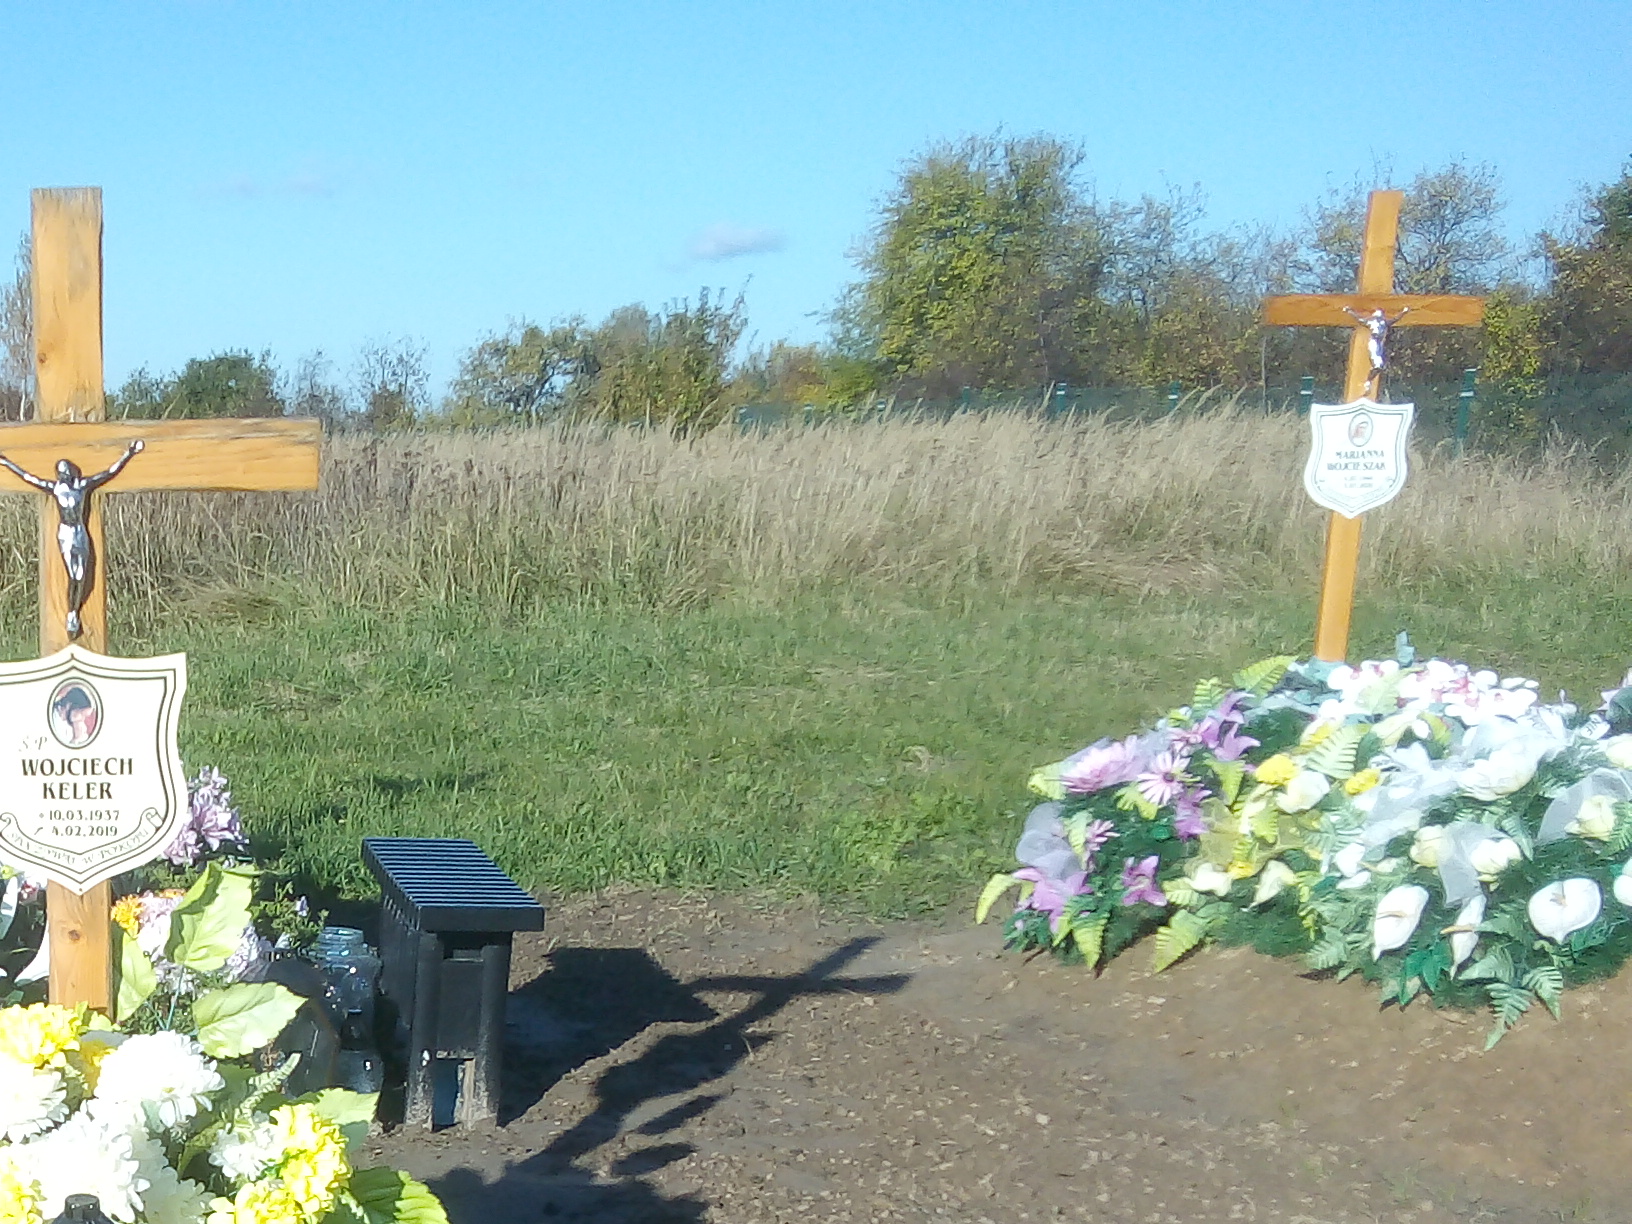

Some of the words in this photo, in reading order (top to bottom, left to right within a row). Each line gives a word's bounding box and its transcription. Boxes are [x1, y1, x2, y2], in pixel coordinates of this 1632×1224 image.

[21, 757, 133, 776] WOJCIECH
[42, 781, 113, 800] KELER
[49, 809, 120, 821] 10.03.1937
